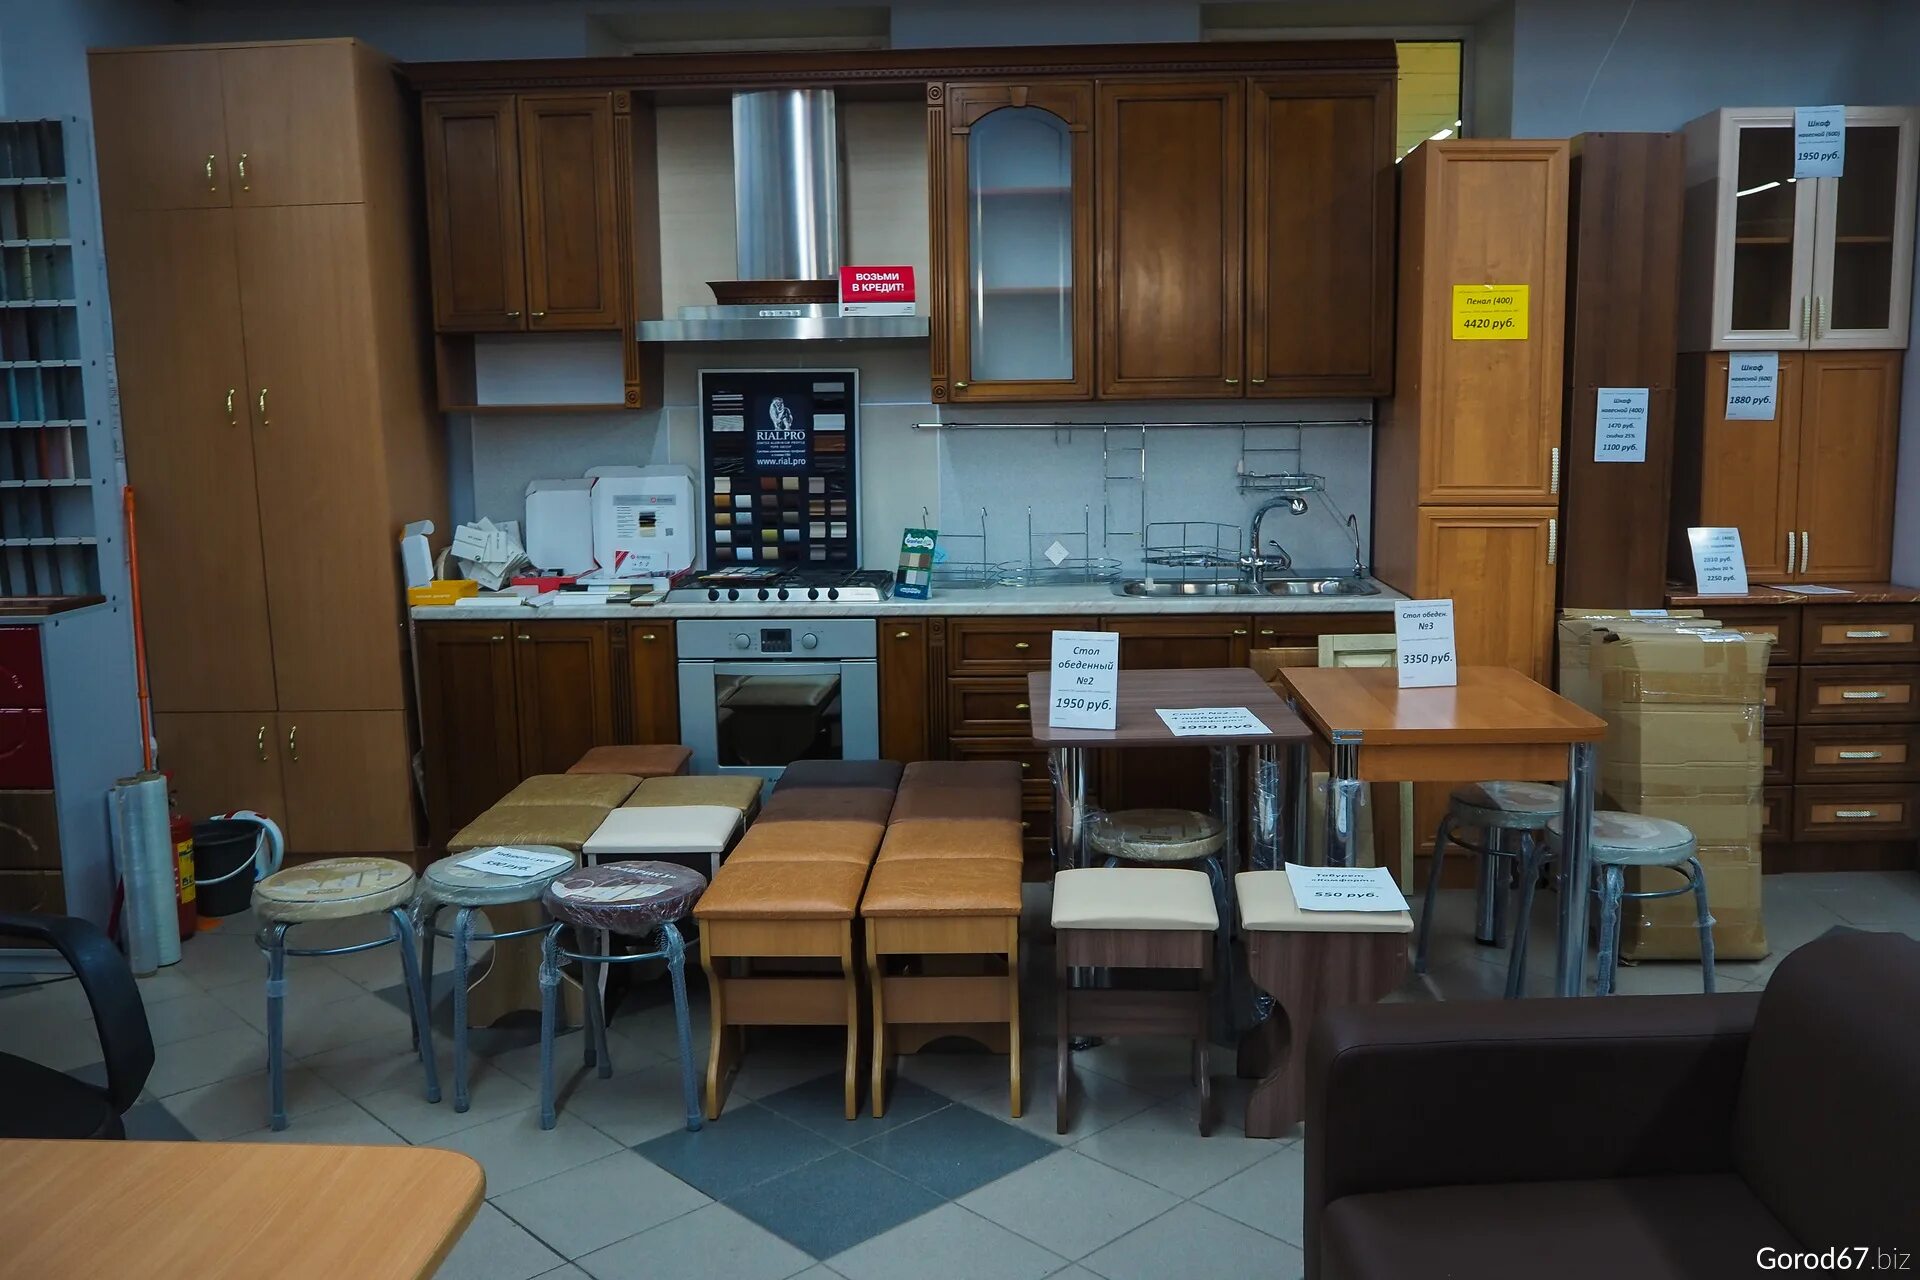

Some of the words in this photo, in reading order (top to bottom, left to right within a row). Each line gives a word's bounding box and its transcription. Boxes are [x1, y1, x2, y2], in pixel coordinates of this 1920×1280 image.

[1807, 120, 1831, 128] Шкаф
[1797, 151, 1820, 161] 1950
[1820, 150, 1841, 162] руб.
[855, 272, 900, 281] ВОЗЬМИ
[852, 283, 860, 292] В
[861, 283, 905, 293] КРЕДИТ!
[1466, 297, 1492, 305] Пенал
[1493, 296, 1514, 306] (400)
[1463, 318, 1491, 329] 4420
[1491, 317, 1516, 330] руб.
[1740, 364, 1764, 372] Шкаф
[1729, 396, 1752, 404] 1880
[1751, 395, 1772, 406] руб.
[1621, 422, 1636, 430] руб.
[1602, 443, 1621, 451] 1100
[1621, 443, 1638, 452] руб.
[756, 457, 807, 467] www.rial.pro
[1719, 556, 1733, 564] руб.
[1722, 574, 1737, 582] руб.
[1422, 610, 1449, 618] обеден.
[1418, 621, 1434, 630] №3
[1073, 646, 1100, 655] Стол
[1403, 653, 1429, 664] 3350
[1430, 652, 1453, 665] руб.
[1058, 659, 1114, 670] обеденный
[1076, 676, 1094, 686] №2
[1055, 697, 1085, 709] 1950
[1086, 699, 1112, 712] руб.
[1346, 891, 1380, 899] руб.
